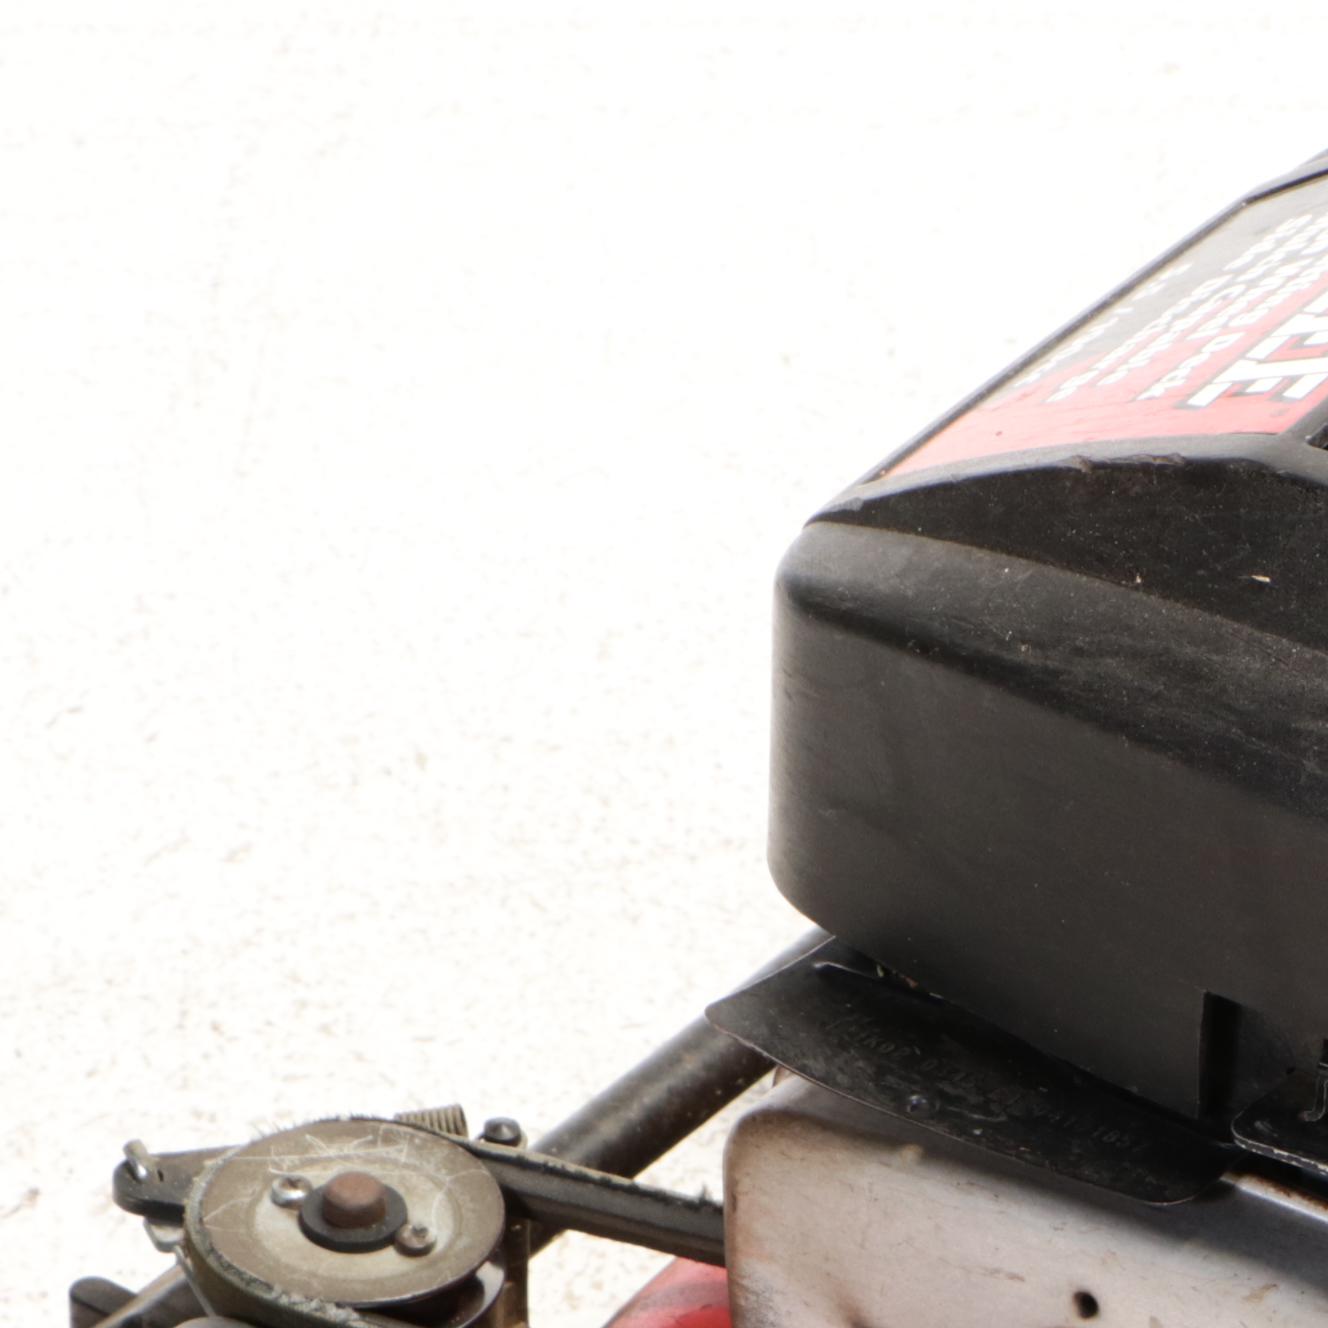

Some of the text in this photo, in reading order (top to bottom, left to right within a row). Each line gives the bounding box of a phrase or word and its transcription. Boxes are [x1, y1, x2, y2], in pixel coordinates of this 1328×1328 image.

[1041, 215, 1313, 401] Side Discharge
[1095, 284, 1250, 385] Capable
[1185, 259, 1313, 338] Wheel
[1134, 333, 1246, 399] Deck
